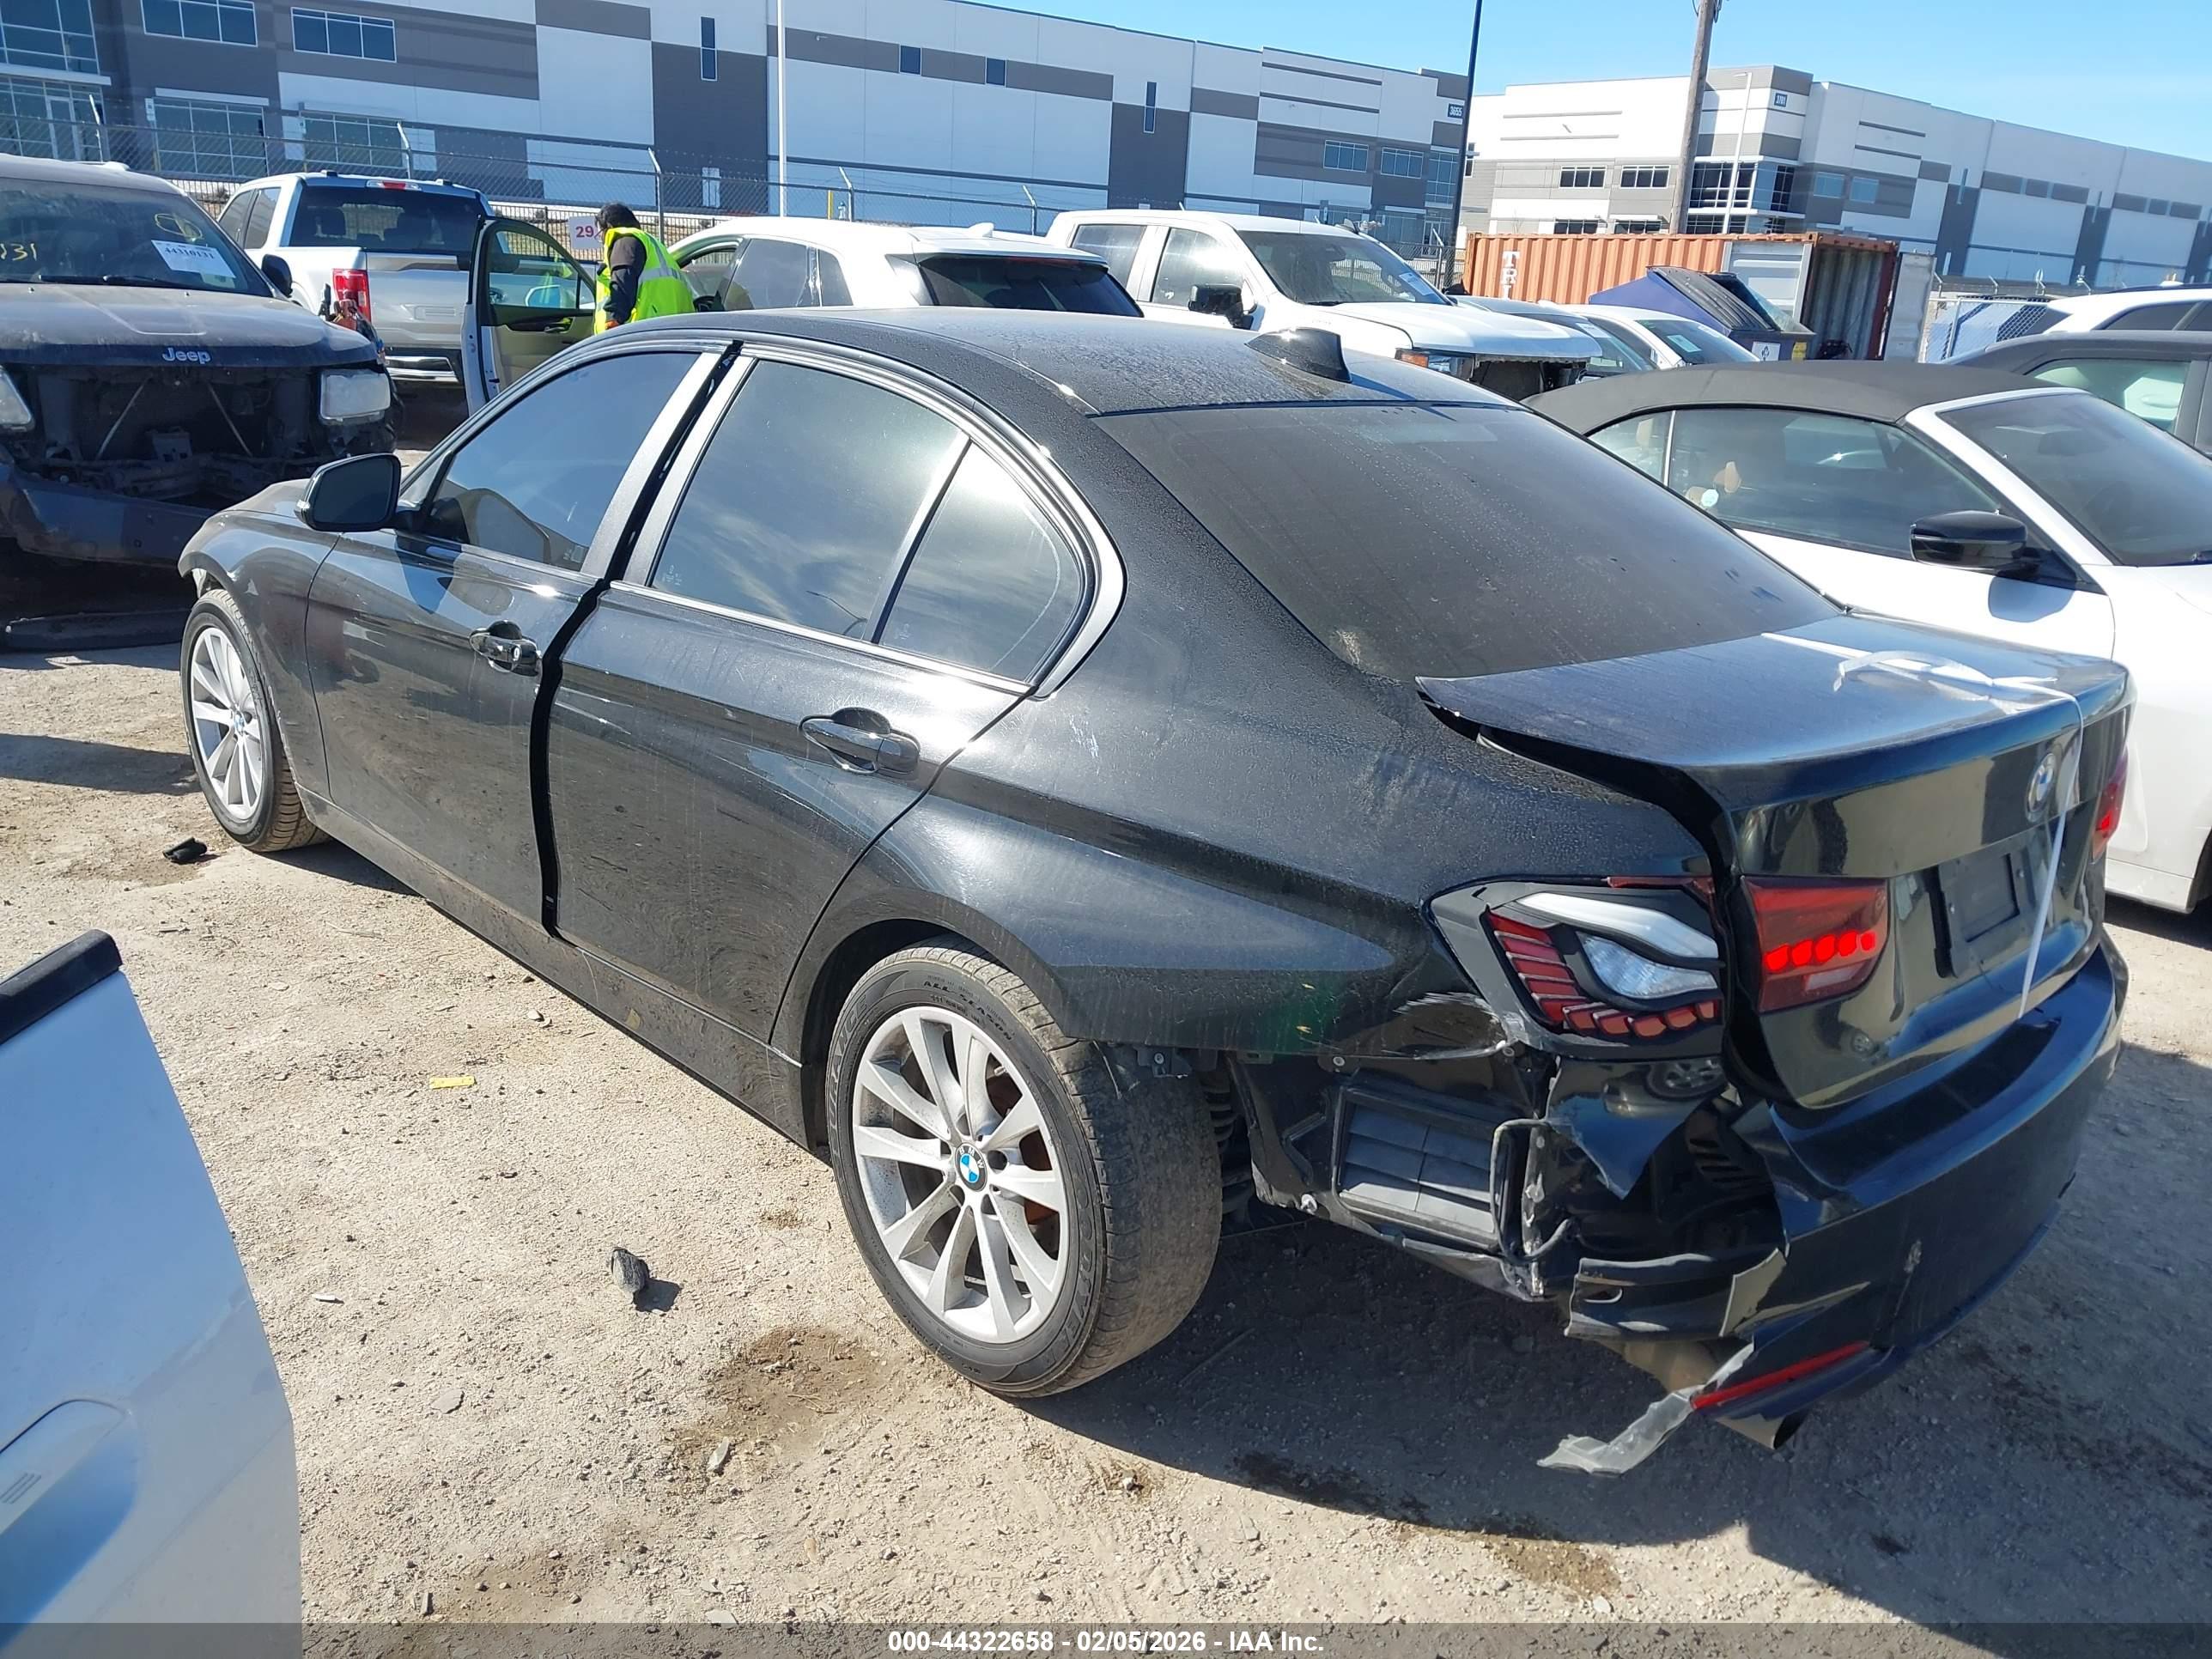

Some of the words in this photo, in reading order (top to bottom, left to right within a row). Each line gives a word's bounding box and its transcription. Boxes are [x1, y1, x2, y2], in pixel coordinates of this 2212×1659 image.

[575, 225, 594, 238] 29
[958, 288, 984, 310] BMW
[161, 347, 211, 364] Jeep
